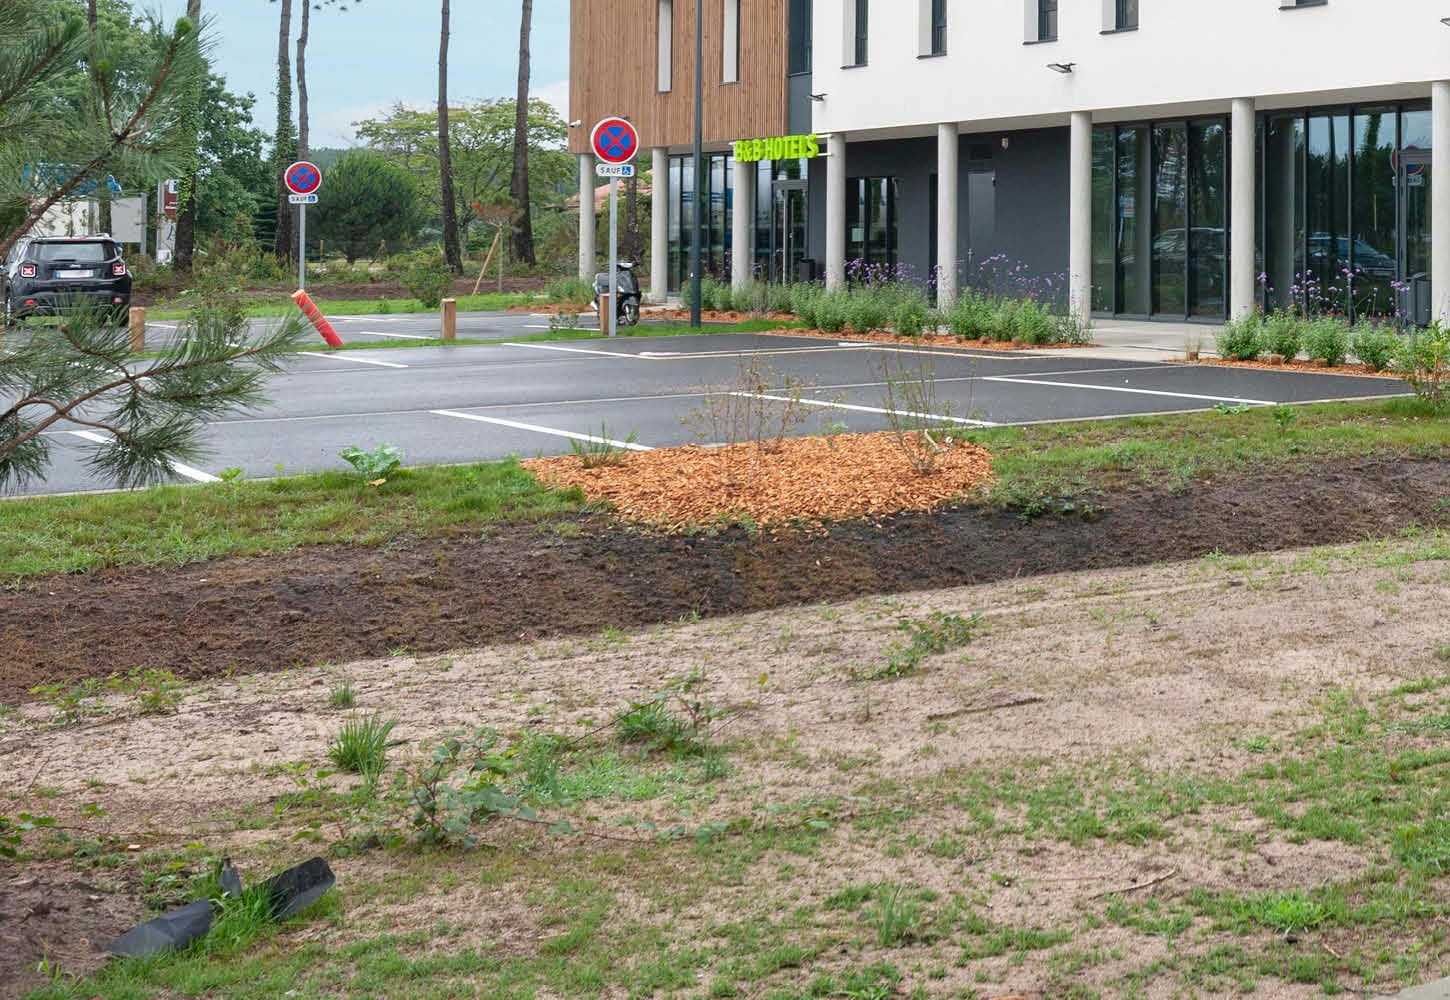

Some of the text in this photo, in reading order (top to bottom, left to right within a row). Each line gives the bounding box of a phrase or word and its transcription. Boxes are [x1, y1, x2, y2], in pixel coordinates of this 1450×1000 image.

[735, 134, 819, 162] B&B HOTELS
[600, 166, 620, 174] SAUF
